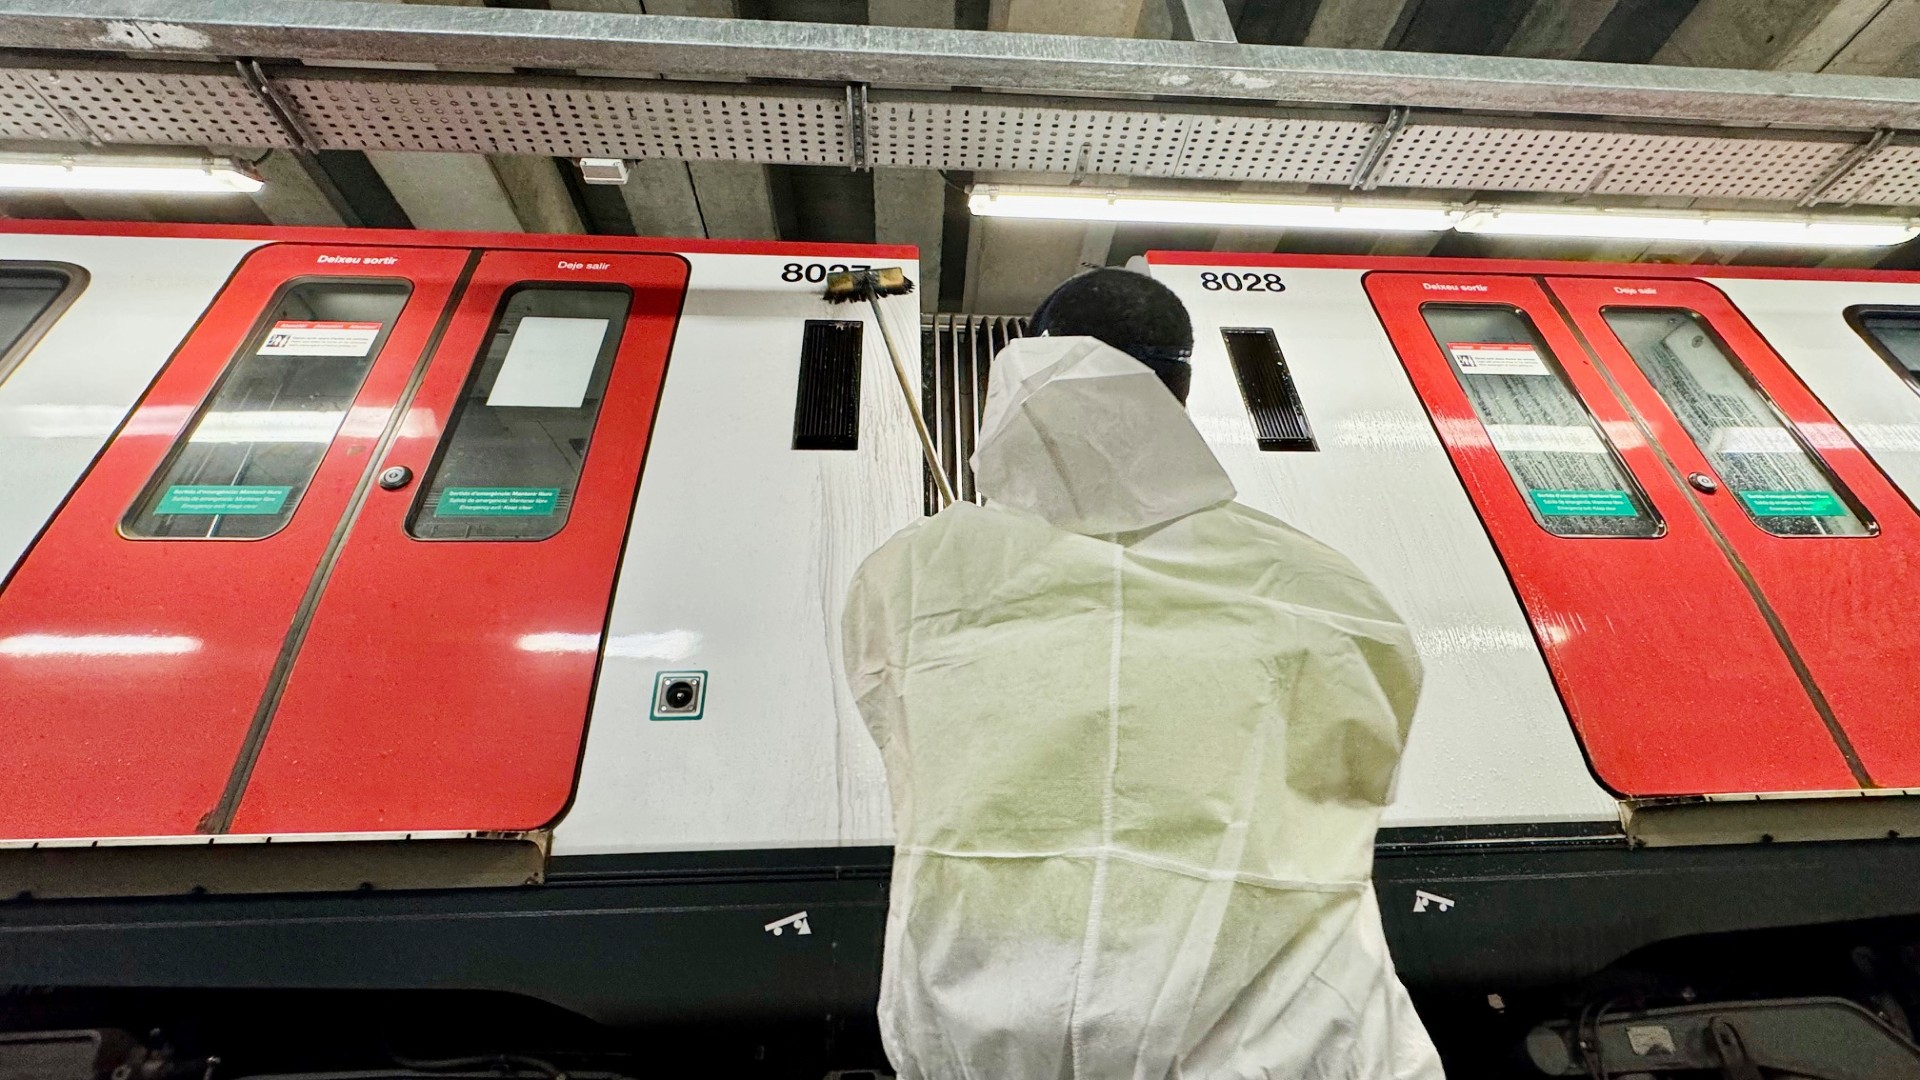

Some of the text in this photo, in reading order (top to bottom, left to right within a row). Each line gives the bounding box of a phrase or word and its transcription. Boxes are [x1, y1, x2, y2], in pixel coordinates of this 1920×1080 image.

[316, 254, 398, 265] Deixeu sortir
[557, 260, 611, 271] Deje salir
[1200, 271, 1286, 293] 8028
[1422, 282, 1489, 292] Deixeu sortir
